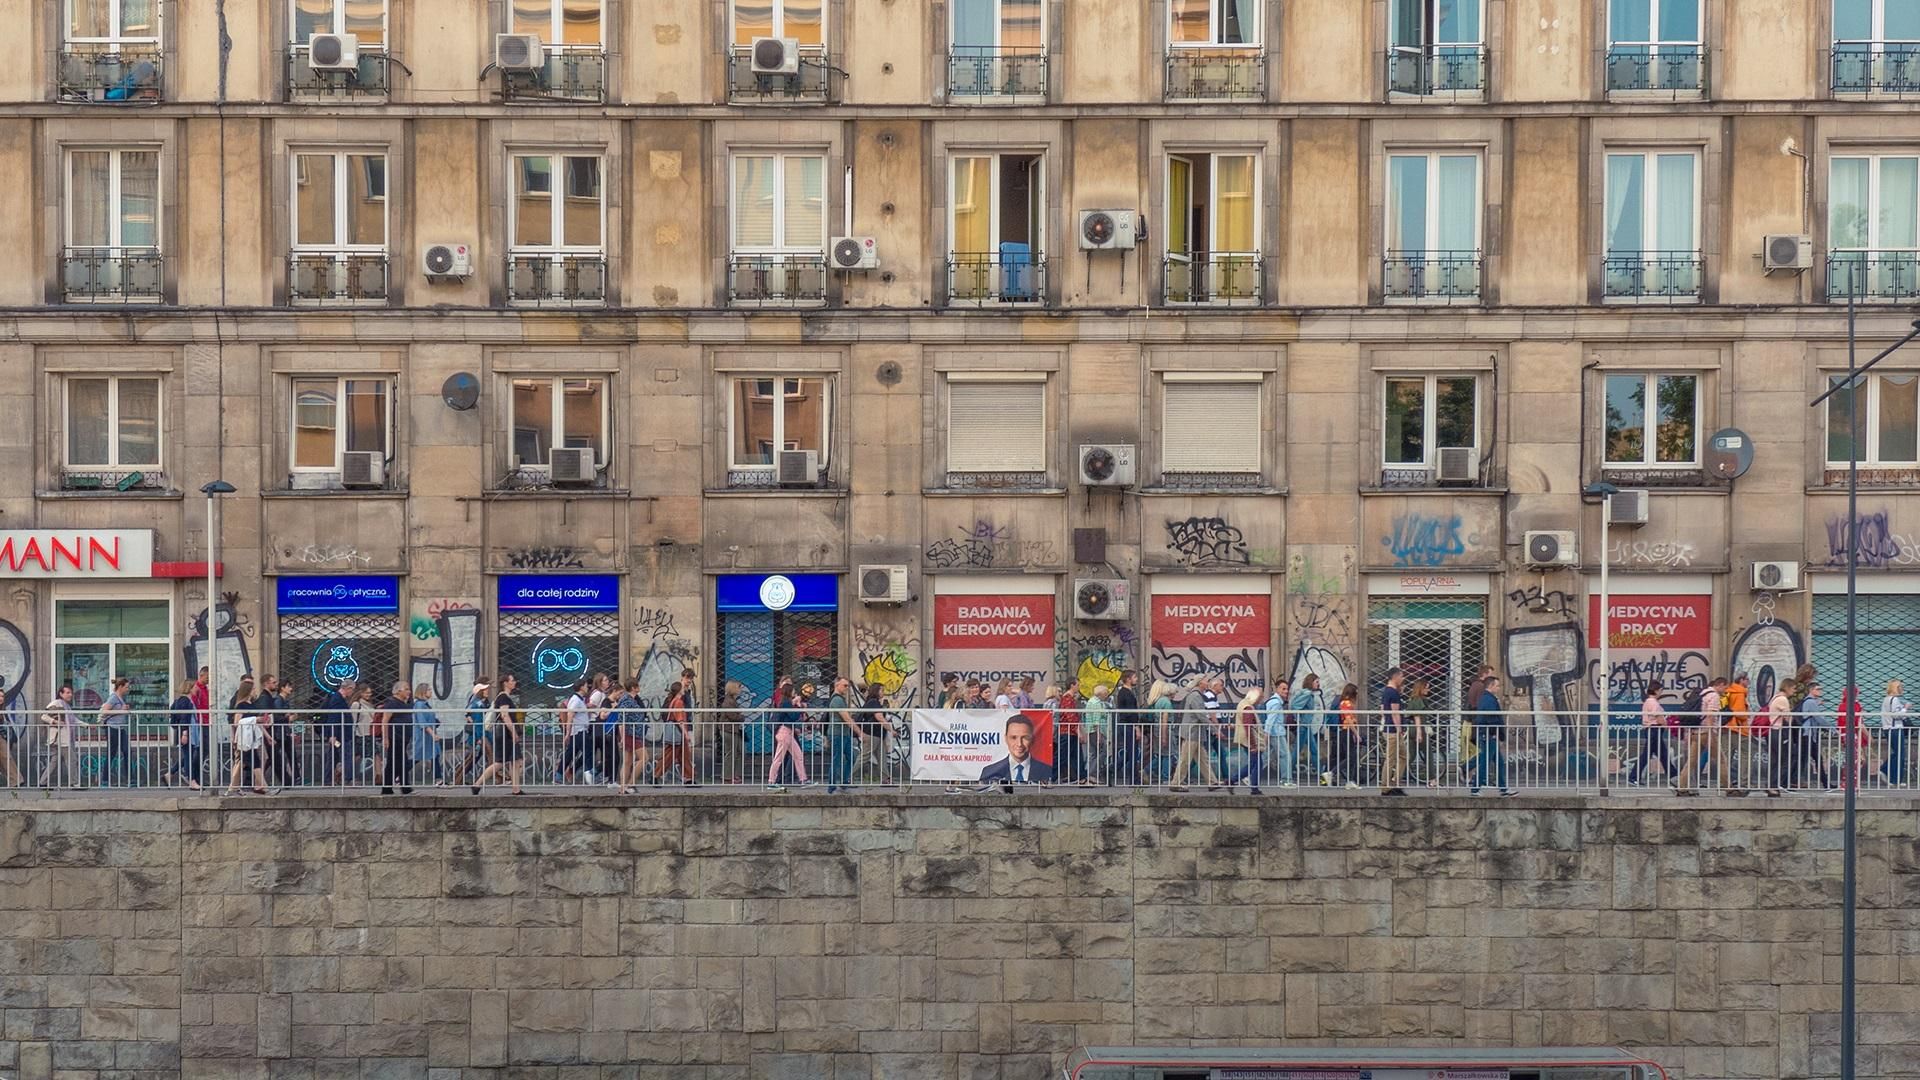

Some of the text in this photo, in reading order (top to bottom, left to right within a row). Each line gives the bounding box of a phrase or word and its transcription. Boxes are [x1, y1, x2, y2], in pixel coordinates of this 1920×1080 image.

[1400, 576, 1456, 585] POPULARNA
[288, 588, 332, 598] pracownia
[349, 588, 386, 598] optyczna
[517, 588, 600, 599] dla całej rodziny
[958, 606, 1031, 619] BADANIA
[1164, 605, 1256, 617] MEDYCYNA
[943, 621, 1046, 636] KIEROWCÓW
[1183, 622, 1238, 634] PRACY
[1620, 623, 1678, 635] PRACY
[950, 723, 968, 731] RAFAŁ
[918, 731, 1000, 745] TRZASKOWSKI
[924, 753, 993, 762] CAŁA POLSKA NAPRZÓD!
